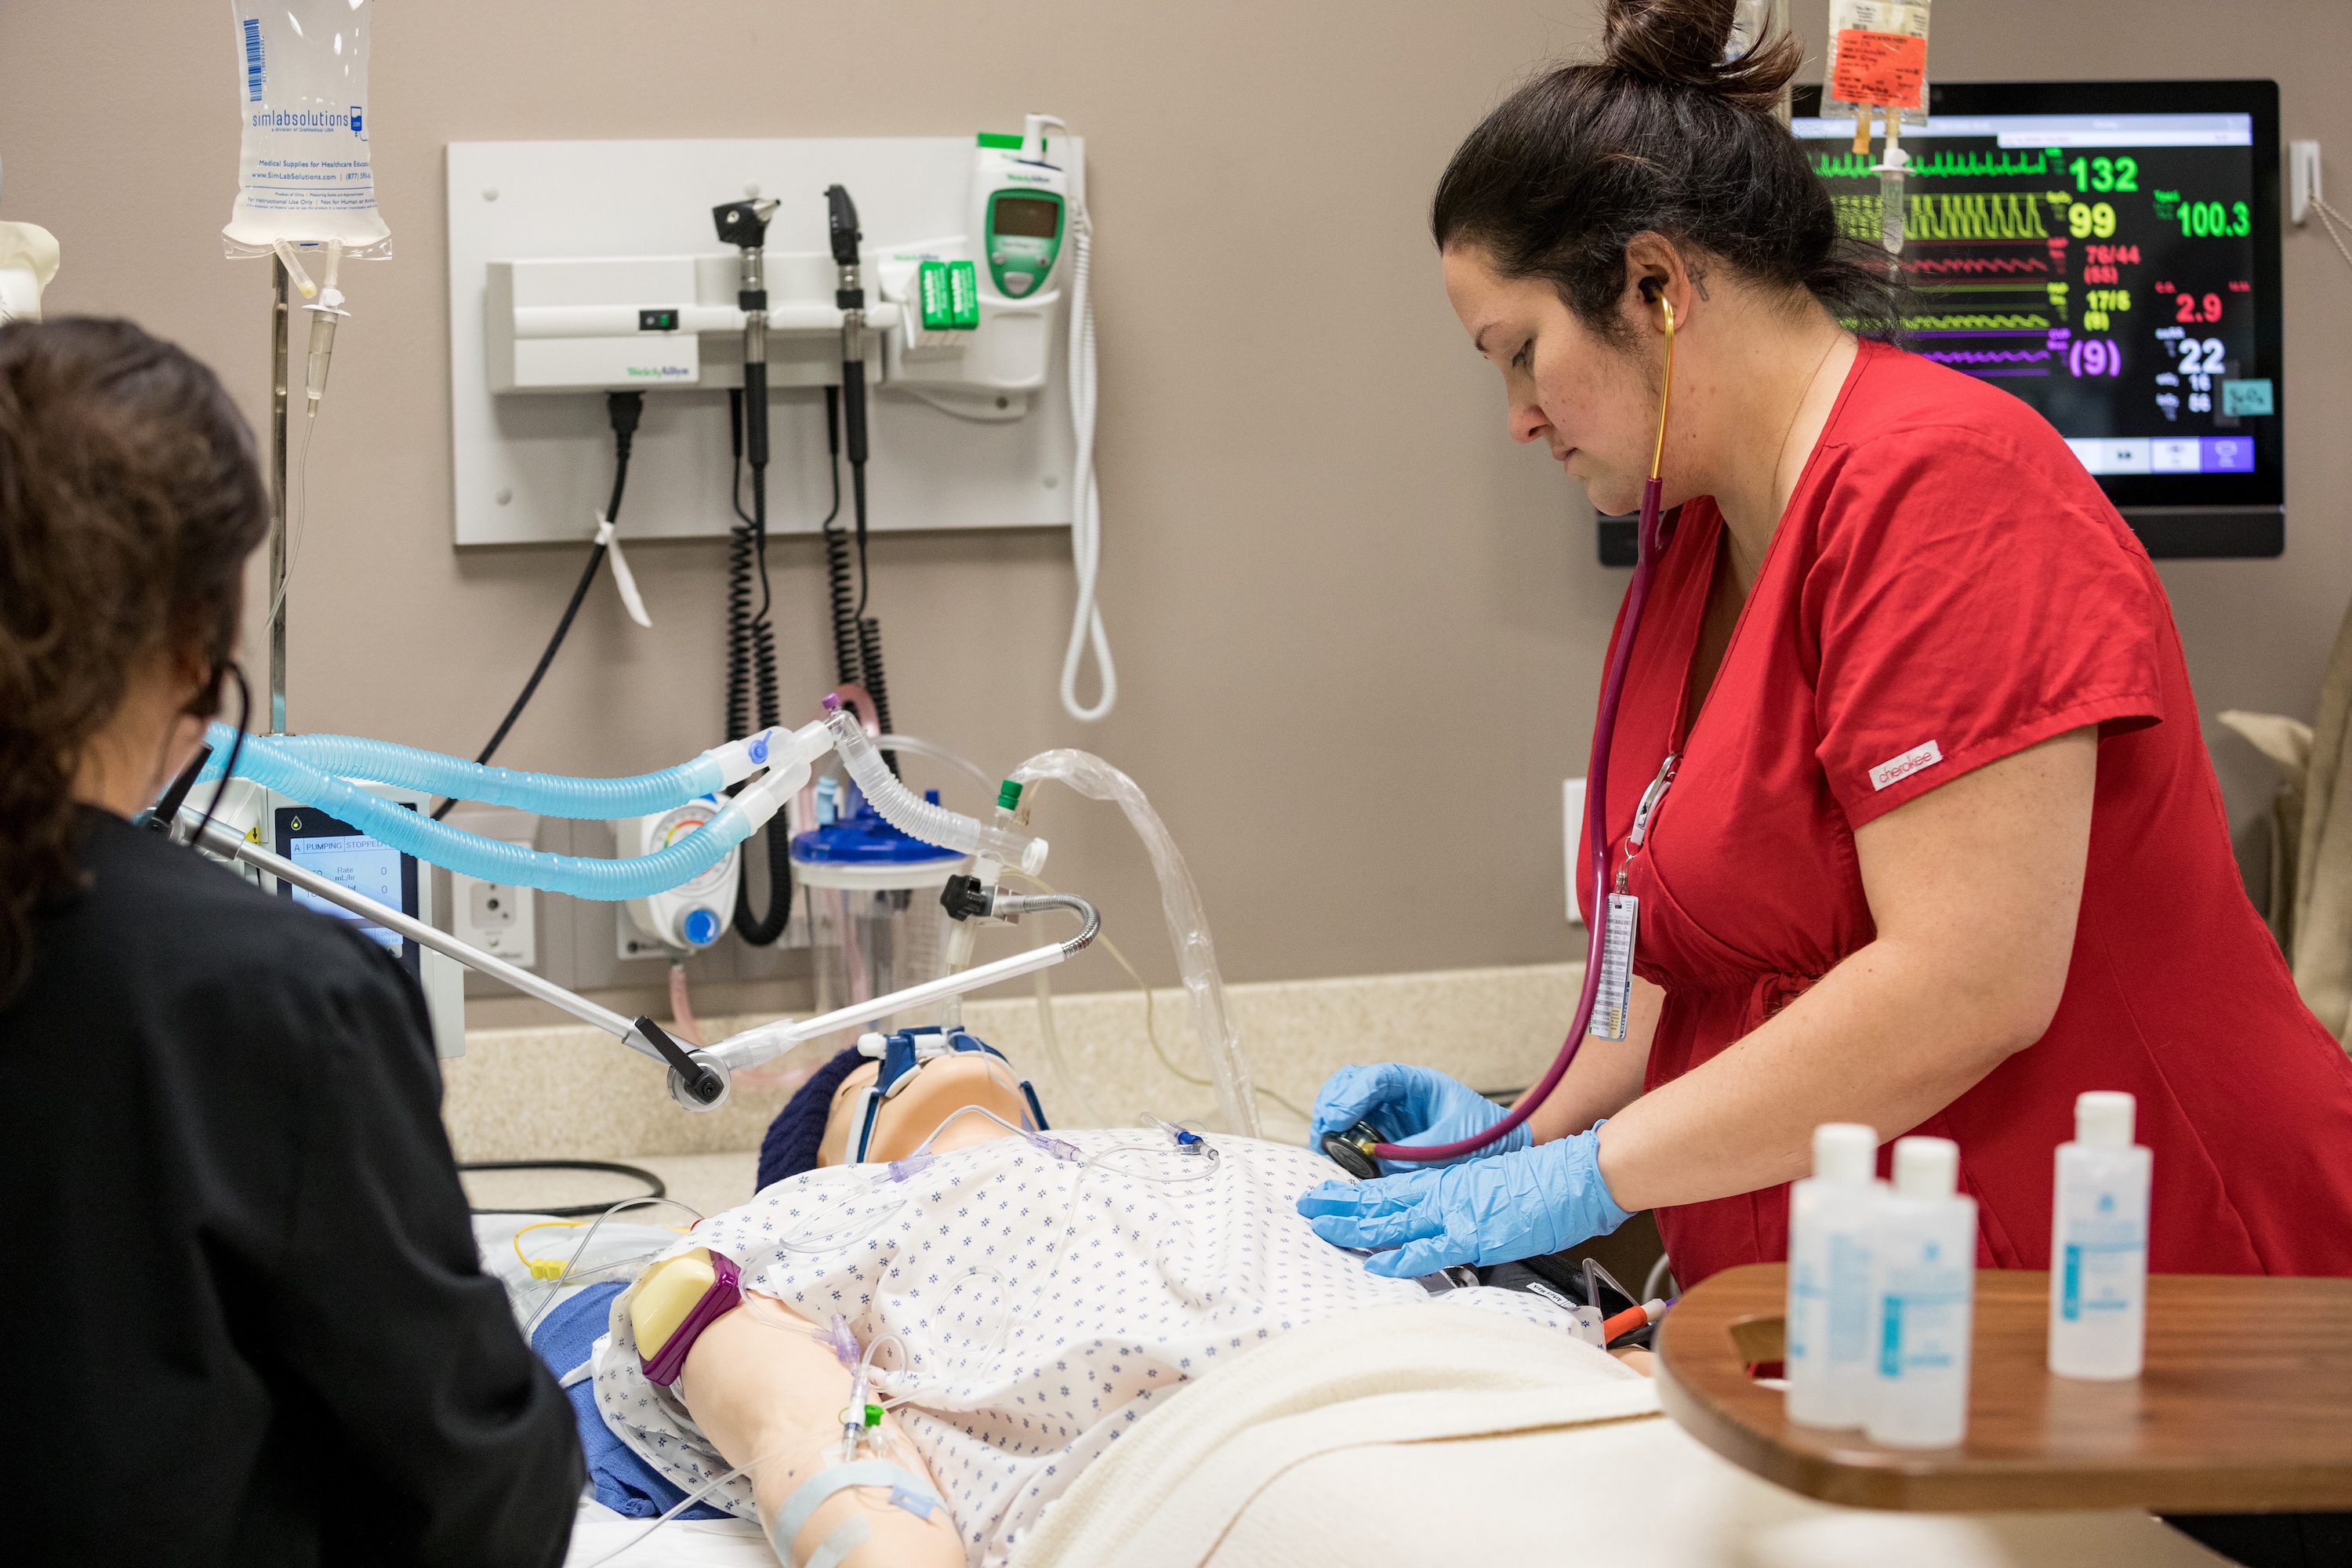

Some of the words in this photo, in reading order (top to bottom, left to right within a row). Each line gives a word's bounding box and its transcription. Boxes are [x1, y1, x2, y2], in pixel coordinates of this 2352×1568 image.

[252, 110, 349, 127] simlabsolutions
[2069, 155, 2139, 193] 132
[2068, 201, 2116, 238] 99
[2176, 201, 2250, 237] 100.3
[2176, 292, 2223, 323] 2.9
[2070, 339, 2122, 377] (9)
[2178, 338, 2226, 375] 22
[1879, 755, 1932, 782] cherokee
[294, 844, 301, 852] A
[307, 842, 343, 851] PUMPING
[346, 840, 383, 848] STOPPED
[380, 866, 387, 876] 0
[381, 885, 387, 894] 0
[1533, 1284, 1546, 1294] Mark
[1546, 1290, 1562, 1301] Artery
